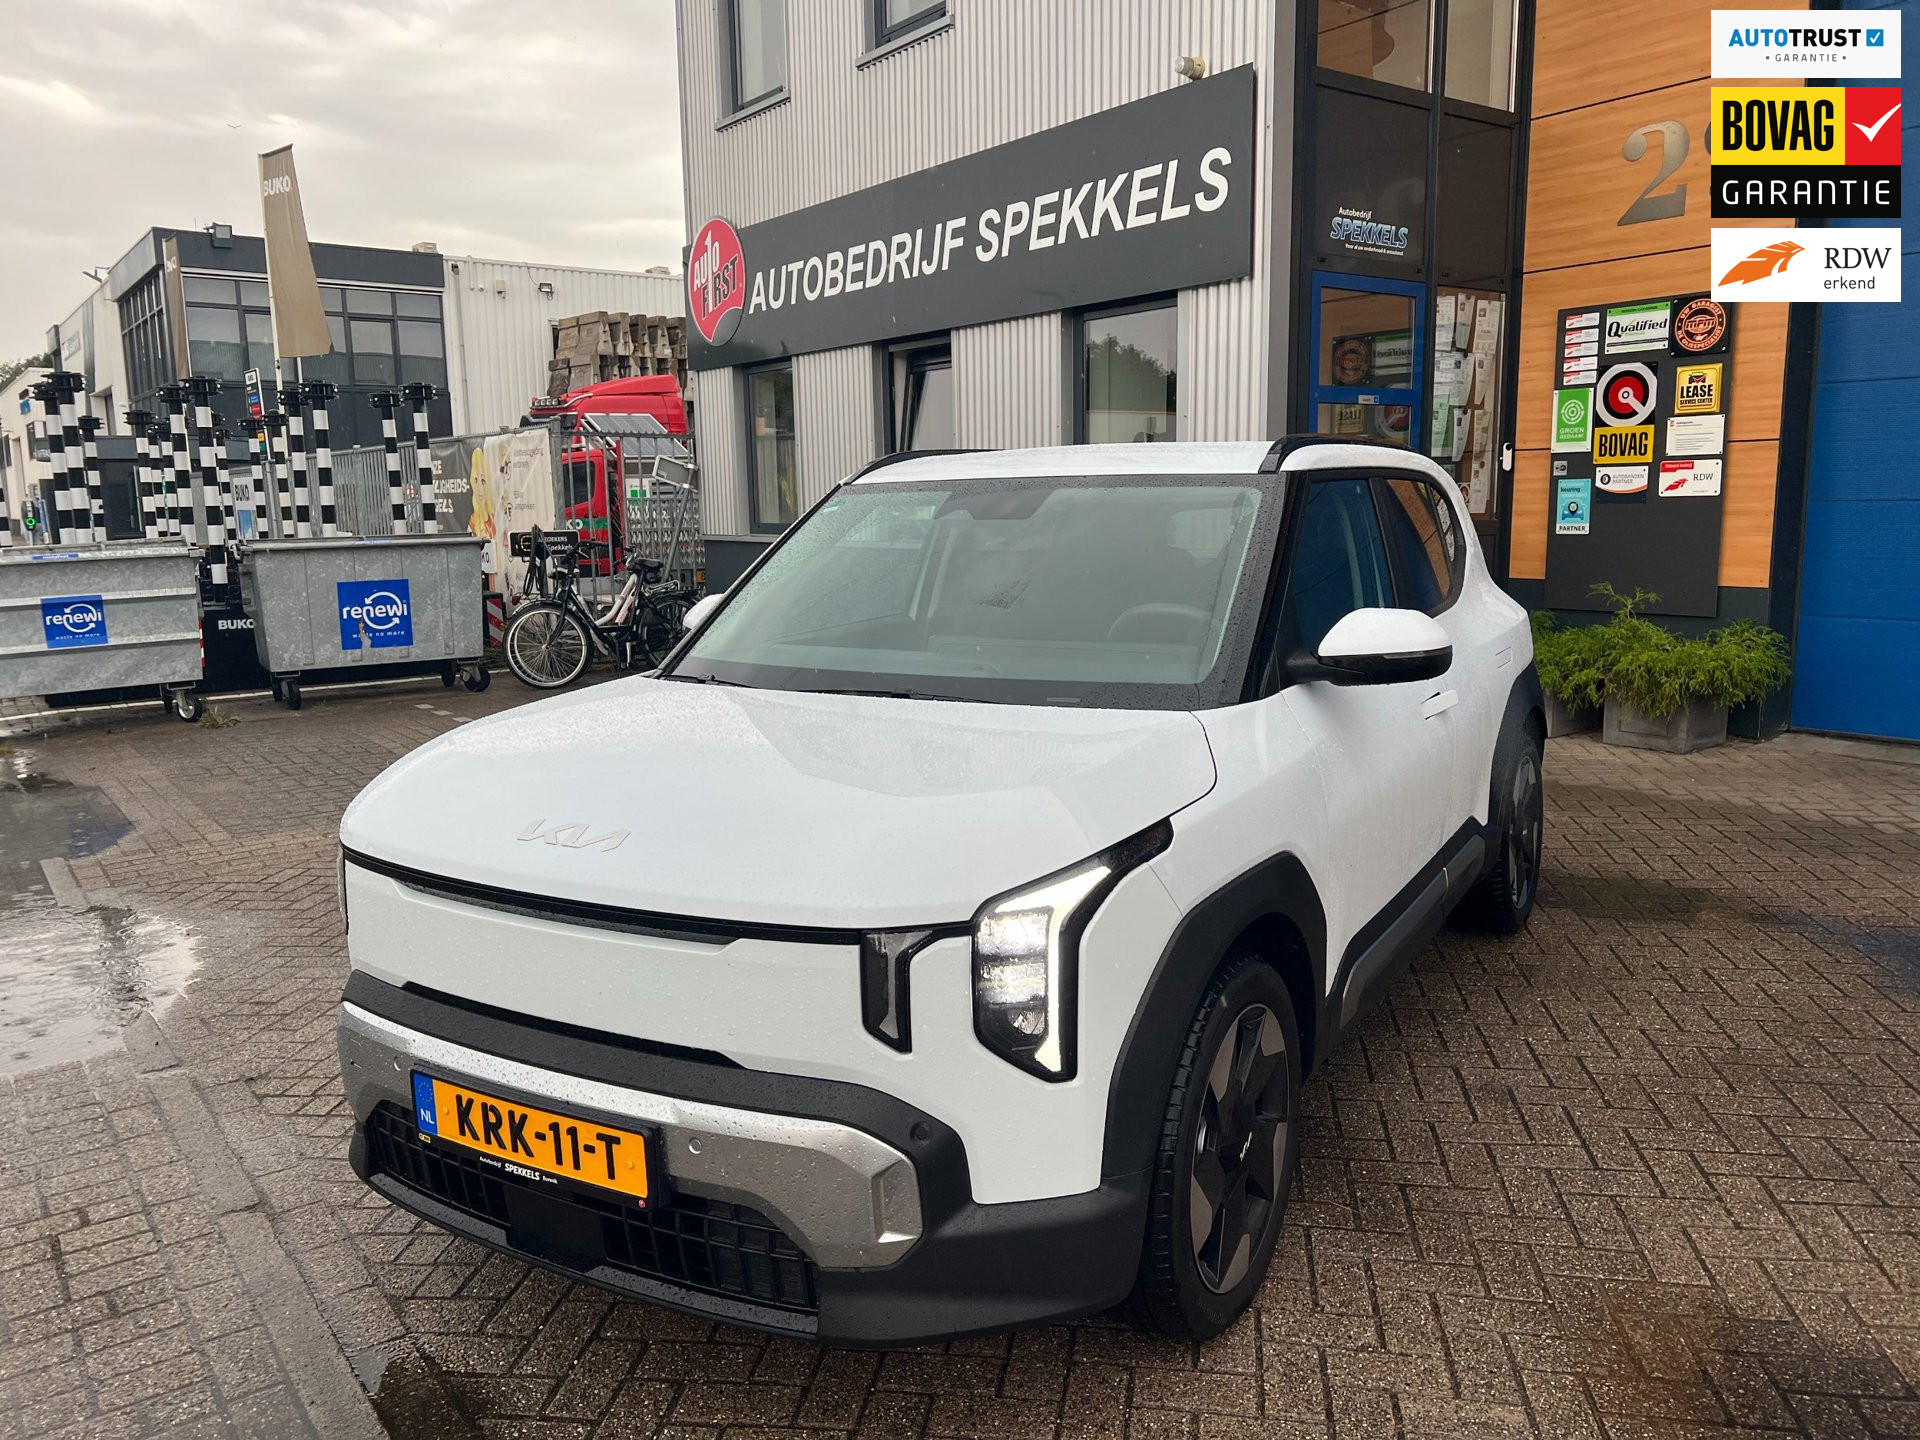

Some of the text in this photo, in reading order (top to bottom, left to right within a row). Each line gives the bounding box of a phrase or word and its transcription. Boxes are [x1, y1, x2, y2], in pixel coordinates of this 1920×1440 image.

[1617, 120, 1711, 226] 2
[1339, 207, 1372, 220] Autobedrijf
[749, 147, 1232, 314] AUTOBEDRIJF SPEKKELS
[1330, 217, 1409, 249] SPEKKELS
[1680, 300, 1721, 318] UW GARAGIST
[1608, 318, 1668, 338] Qualified
[1680, 384, 1713, 398] LEASE
[1599, 432, 1649, 457] BOVAG
[1693, 473, 1713, 481] RDW
[45, 608, 102, 625] renewi
[342, 600, 407, 619] renewi
[420, 1108, 435, 1124] NL
[455, 1094, 621, 1180] KRK-11-T
[504, 1162, 540, 1180] SPEKKELS
